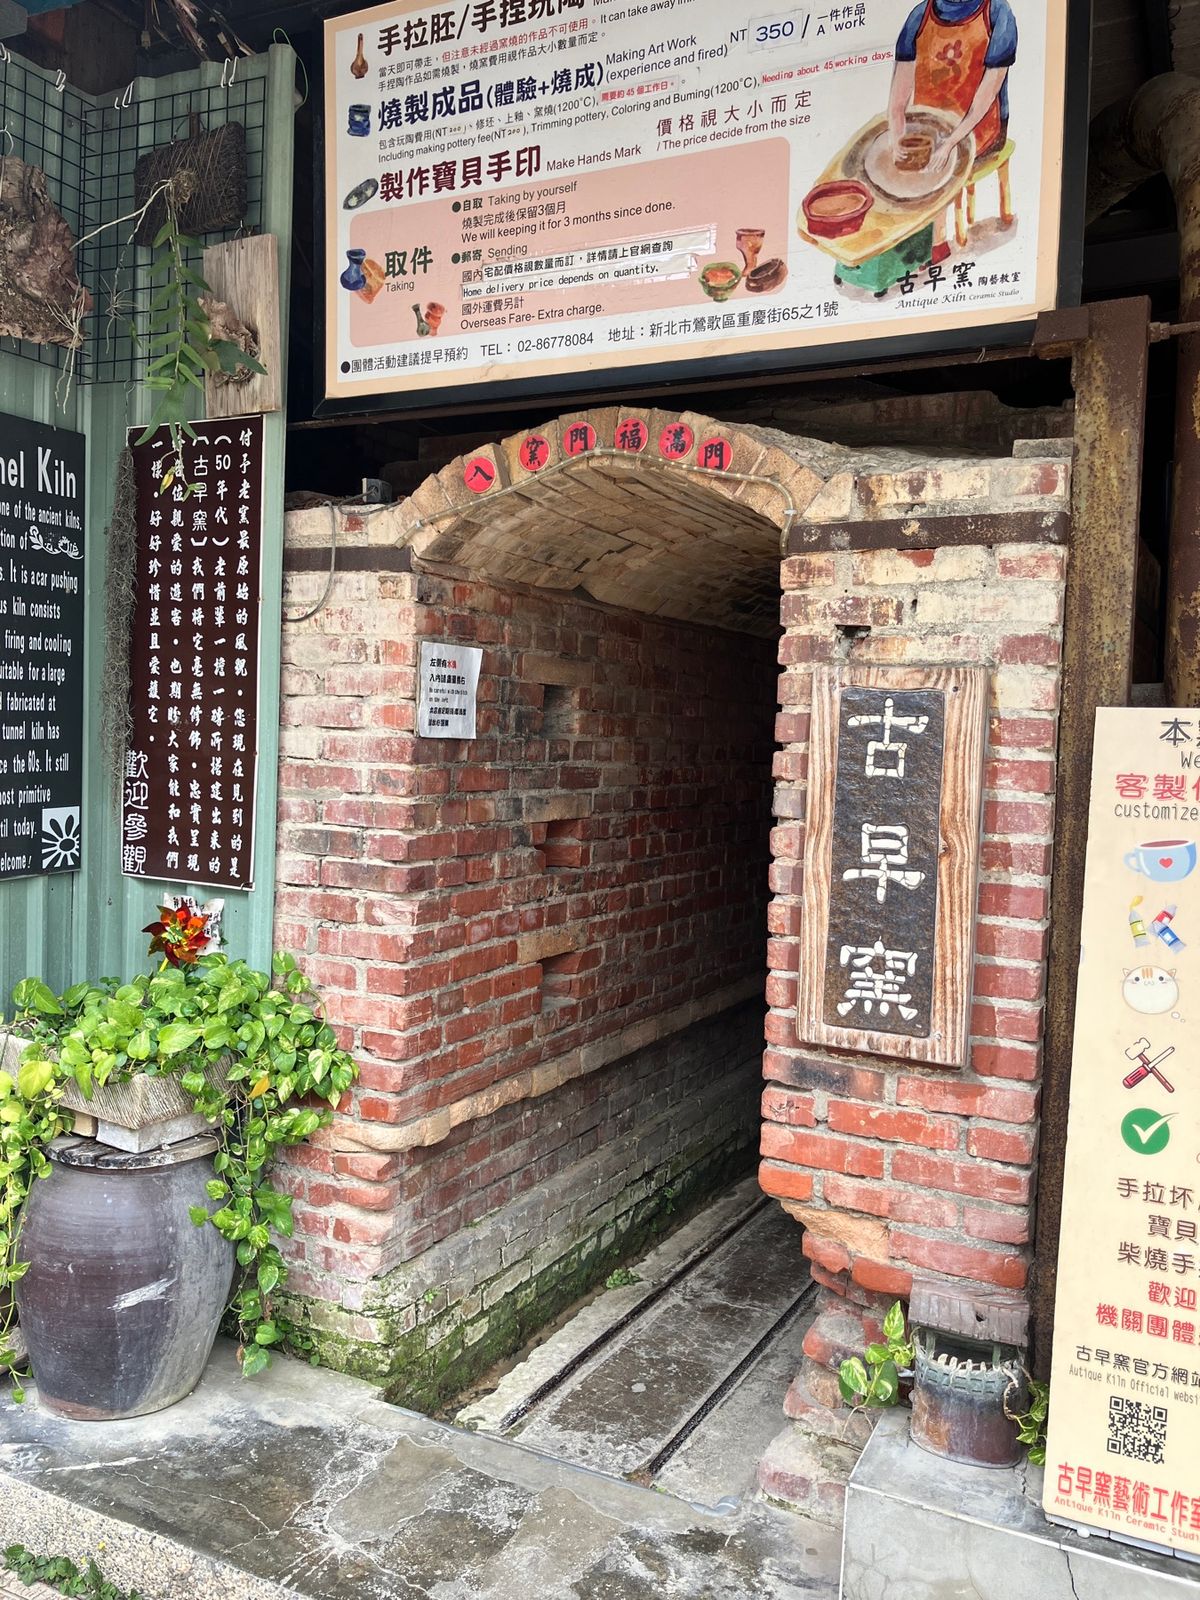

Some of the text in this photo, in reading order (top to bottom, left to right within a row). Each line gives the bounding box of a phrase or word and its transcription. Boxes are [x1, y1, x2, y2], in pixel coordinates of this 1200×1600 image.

[600, 14, 607, 24] It
[609, 10, 626, 22] can
[628, 5, 648, 18] take
[650, 0, 675, 12] away
[730, 3, 866, 43] NT 350 一件作品
[816, 16, 866, 37] A work
[606, 35, 697, 66] Making Art Work
[606, 44, 728, 83] (experience and fired)
[378, 150, 414, 163] Including
[416, 143, 446, 156] making
[447, 137, 475, 151] pottery
[531, 116, 573, 132] Trimming
[574, 110, 609, 127] pottery,
[611, 101, 651, 117] Coloring
[653, 95, 671, 108] and
[762, 70, 794, 84] Needing
[797, 64, 820, 77] about
[823, 61, 834, 70] 45
[835, 54, 868, 68] working
[871, 51, 894, 62] days.
[657, 90, 812, 137] 價格視大小而定
[663, 113, 811, 150] The price decide from the size
[380, 145, 642, 202] 製作寶貝手印 Make Hands Mark
[463, 181, 578, 212] 自取 Taking by yourself
[461, 199, 676, 243] We will keeping it for 3 months since done.
[385, 246, 434, 279] 取件
[461, 244, 528, 263] 郵寄 Sending
[385, 280, 415, 293] Taking
[463, 263, 659, 298] Home delivery price depends on quantity.
[895, 262, 976, 296] 古早窯
[461, 296, 525, 316] 國外運費另計
[895, 289, 1020, 309] Antique Kiln Ceramic Studio
[460, 316, 507, 330] Overseas
[538, 307, 564, 320] Extra
[566, 303, 605, 317] charge.
[351, 346, 468, 374] 團體活動建議提早預約
[517, 332, 594, 353] 02-86778084
[37, 446, 77, 499] Kiln
[14, 500, 22, 519] of
[25, 501, 36, 522] the
[38, 506, 62, 526] ancient
[19, 531, 28, 551] of
[10, 558, 78, 595] It is a car pushing
[12, 595, 61, 620] kiln consists
[5, 629, 72, 657] firing and cooling
[28, 661, 40, 681] for
[41, 667, 46, 681] a
[47, 662, 66, 686] large
[7, 691, 45, 712] fabricated
[48, 695, 56, 712] at
[2, 720, 60, 740] tunnel kiln has
[13, 754, 26, 774] the
[45, 749, 52, 772] It
[55, 752, 69, 772] still
[18, 784, 51, 808] primitive
[123, 749, 149, 875] 歡迎參觀
[1114, 802, 1199, 821] customize
[13, 816, 38, 839] today.
[837, 697, 930, 1022] 古早窯
[1148, 1280, 1197, 1311] 歡迎
[1106, 1372, 1126, 1389] Kiln
[1130, 1379, 1169, 1398] Official
[1054, 1496, 1093, 1513] Antique
[1098, 1508, 1121, 1521] Kiln
[1126, 1516, 1166, 1533] Ceramic
